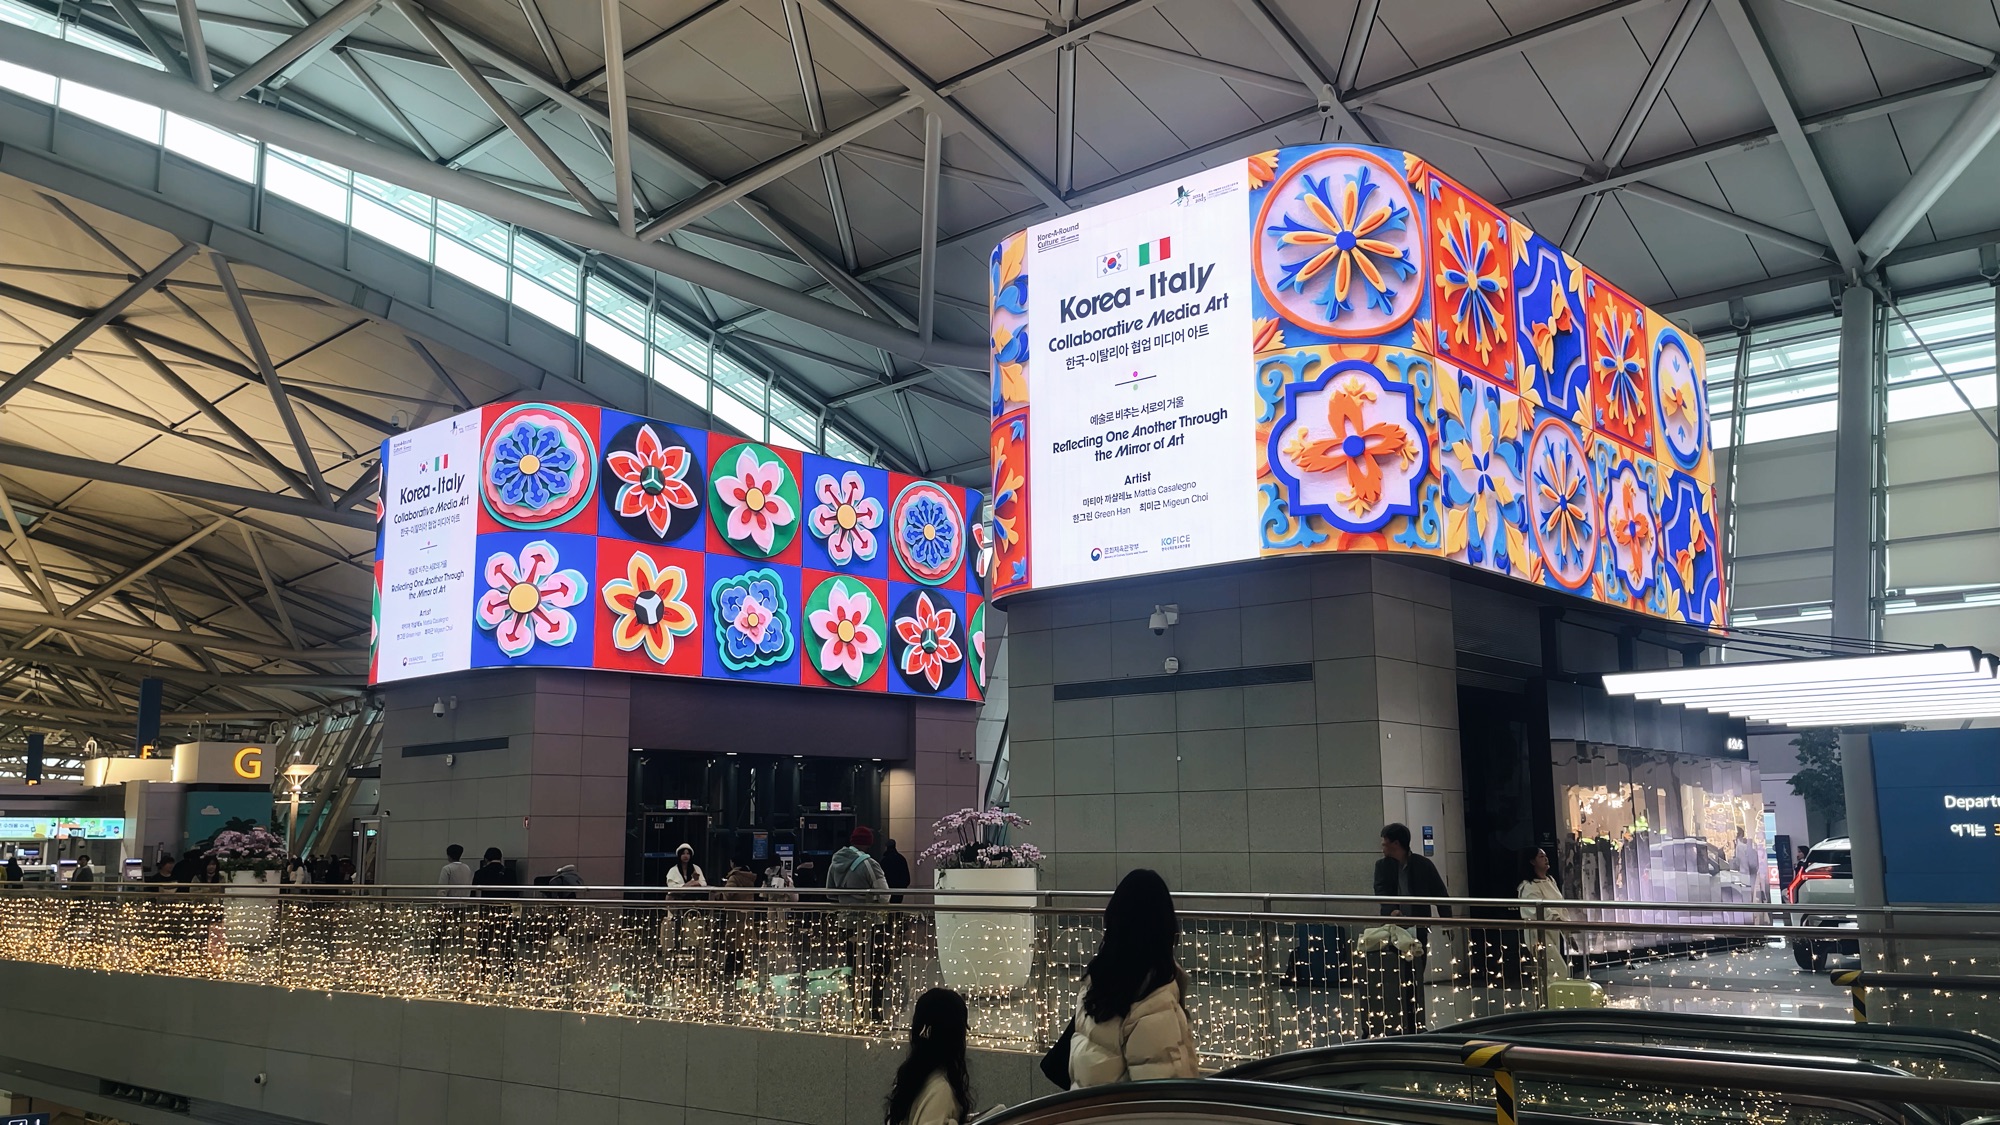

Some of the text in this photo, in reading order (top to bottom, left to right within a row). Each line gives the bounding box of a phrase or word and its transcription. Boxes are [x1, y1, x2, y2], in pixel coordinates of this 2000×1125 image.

[1037, 237, 1059, 249] Culture
[1060, 286, 1131, 324] Korea
[1150, 262, 1216, 300] Italy
[1048, 292, 1229, 353] Collaborative Media Art
[1065, 323, 1210, 371] 한국-이탈리아 협업 미디어 아트
[1090, 395, 1185, 426] 예술로 비추는 서로의 거울
[1052, 408, 1228, 454] Reflecting One Another Through
[1095, 433, 1185, 462] the Mirror of Art
[400, 484, 431, 505] Korea
[438, 473, 465, 495] Italy
[1124, 471, 1151, 486] Artist
[1134, 484, 1157, 499] Mattia
[1158, 480, 1197, 497] Casalegno
[393, 494, 470, 524] Collaborative Media Art
[1072, 506, 1131, 524] 한그린 Green Han
[1163, 496, 1190, 509] Migeun
[1191, 492, 1209, 505] Choi
[1161, 534, 1191, 546] KOFICE
[142, 745, 154, 759] F
[233, 747, 262, 779] G
[1950, 823, 1987, 837] 여기는
